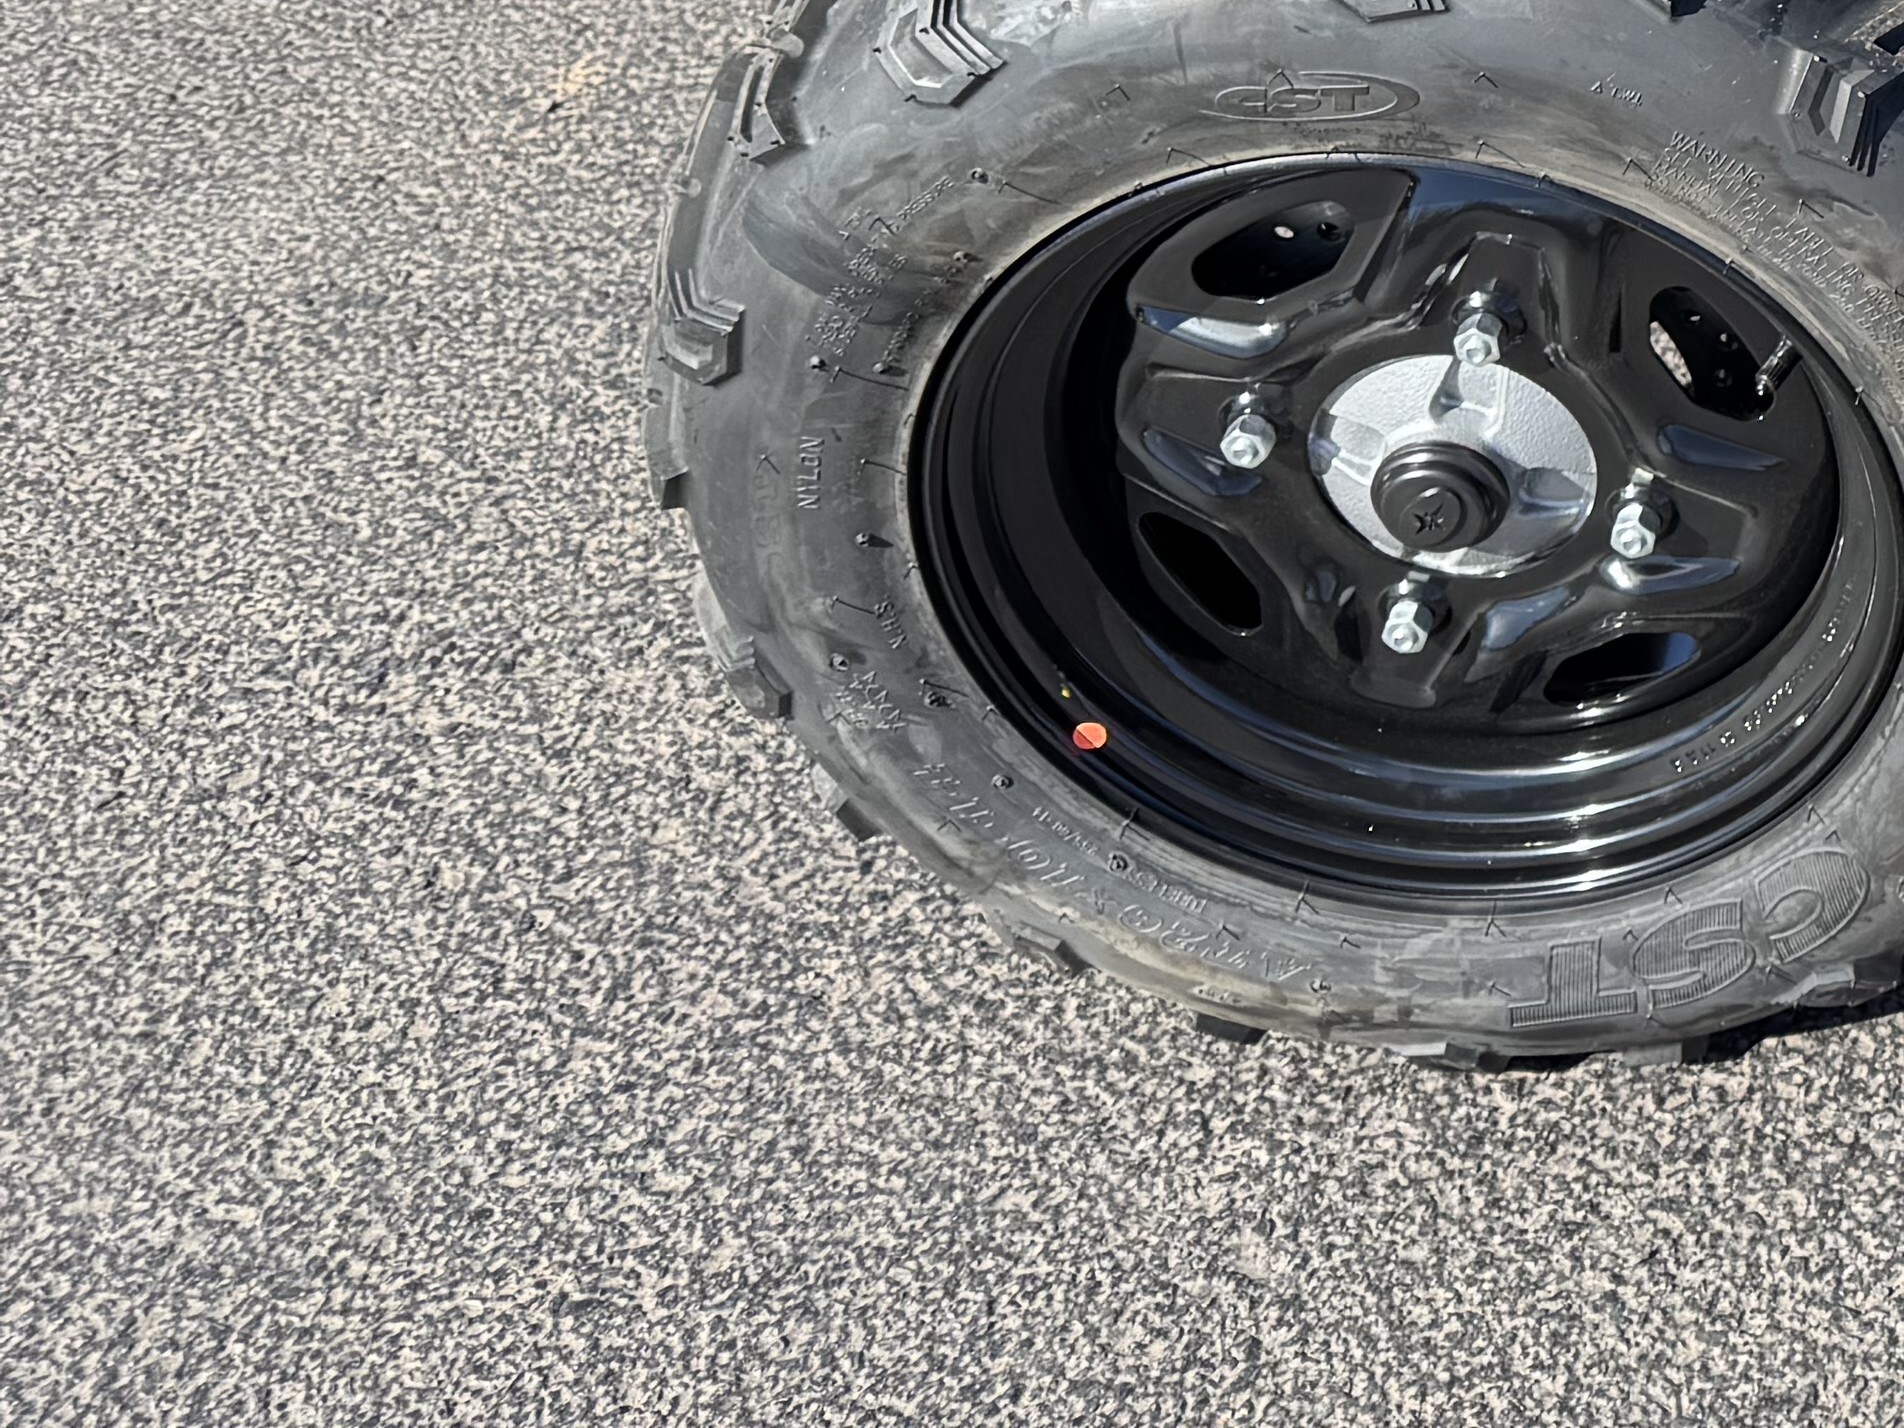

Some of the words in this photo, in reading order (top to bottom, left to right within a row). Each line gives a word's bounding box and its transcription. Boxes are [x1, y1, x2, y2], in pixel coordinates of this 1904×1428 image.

[1215, 84, 1371, 114] CST
[1668, 130, 1764, 190] WARNING
[794, 433, 826, 510] NYLON
[1509, 850, 1871, 1027] CST
